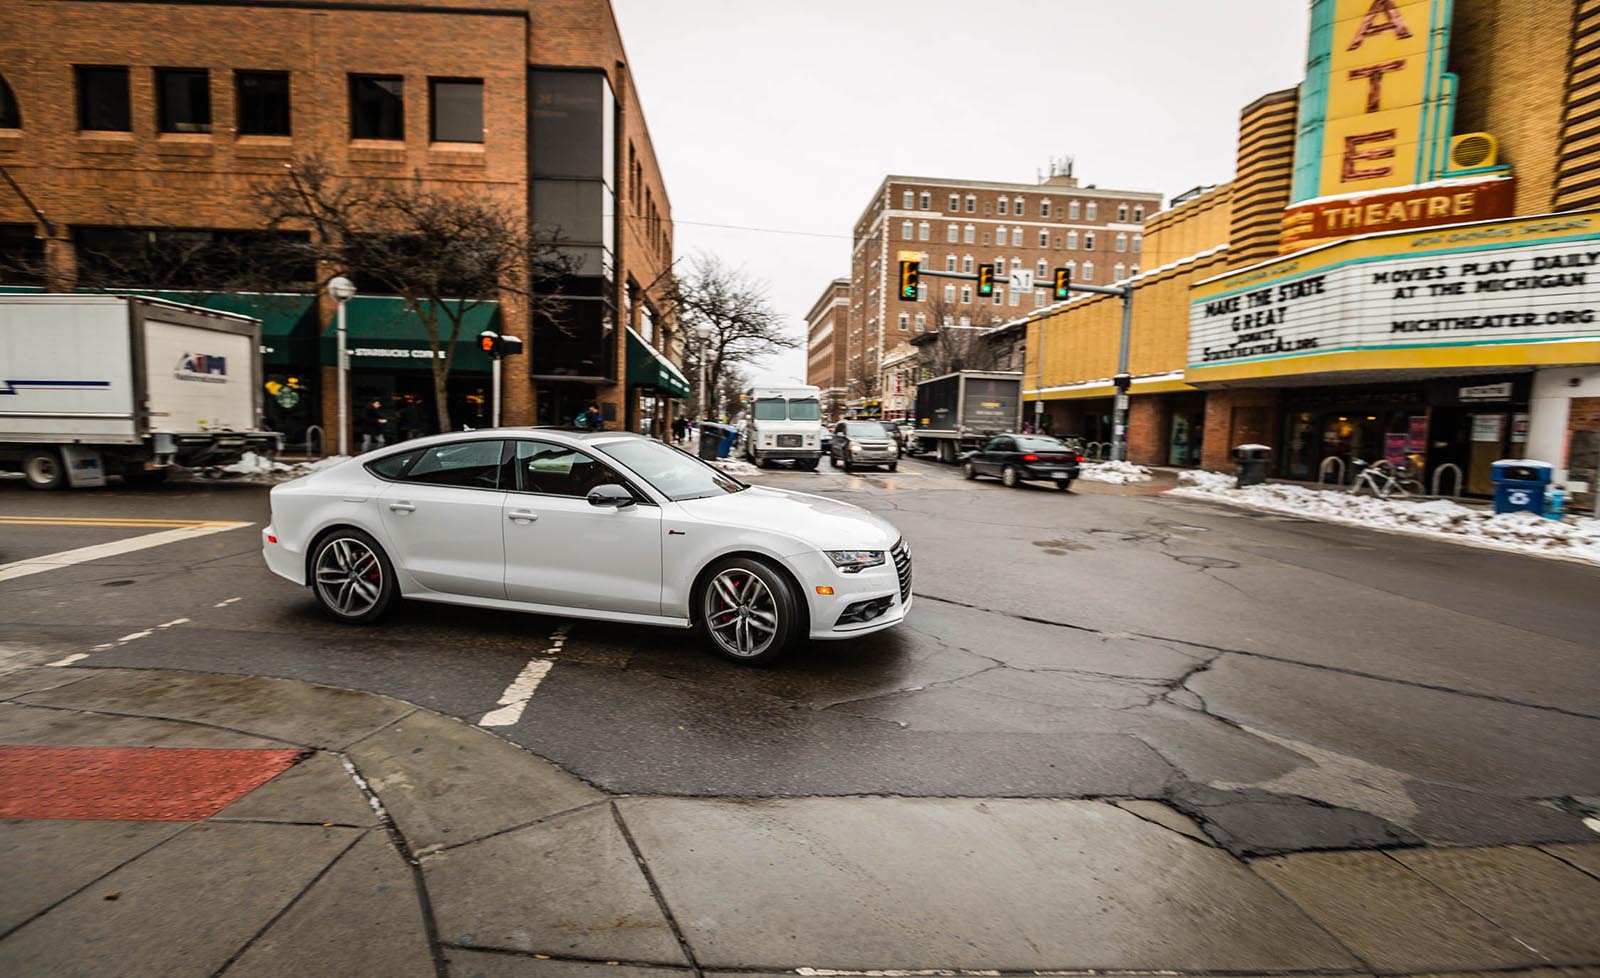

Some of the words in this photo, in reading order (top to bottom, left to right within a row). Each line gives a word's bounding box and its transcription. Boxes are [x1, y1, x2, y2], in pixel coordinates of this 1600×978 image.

[1321, 192, 1475, 229] THEATRE
[1372, 266, 1448, 284] MOVIES
[1460, 259, 1515, 277] PLAY
[1532, 251, 1600, 271] DAILY
[1205, 297, 1241, 318] MAKE
[1245, 287, 1274, 309] THE
[1277, 274, 1326, 303] STATE
[1392, 285, 1420, 300] AT
[1427, 281, 1468, 297] THE
[1474, 272, 1588, 293] MICHIGAN
[1231, 306, 1288, 331] GREAT
[1390, 309, 1596, 333] MICHTHEATER.ORG
